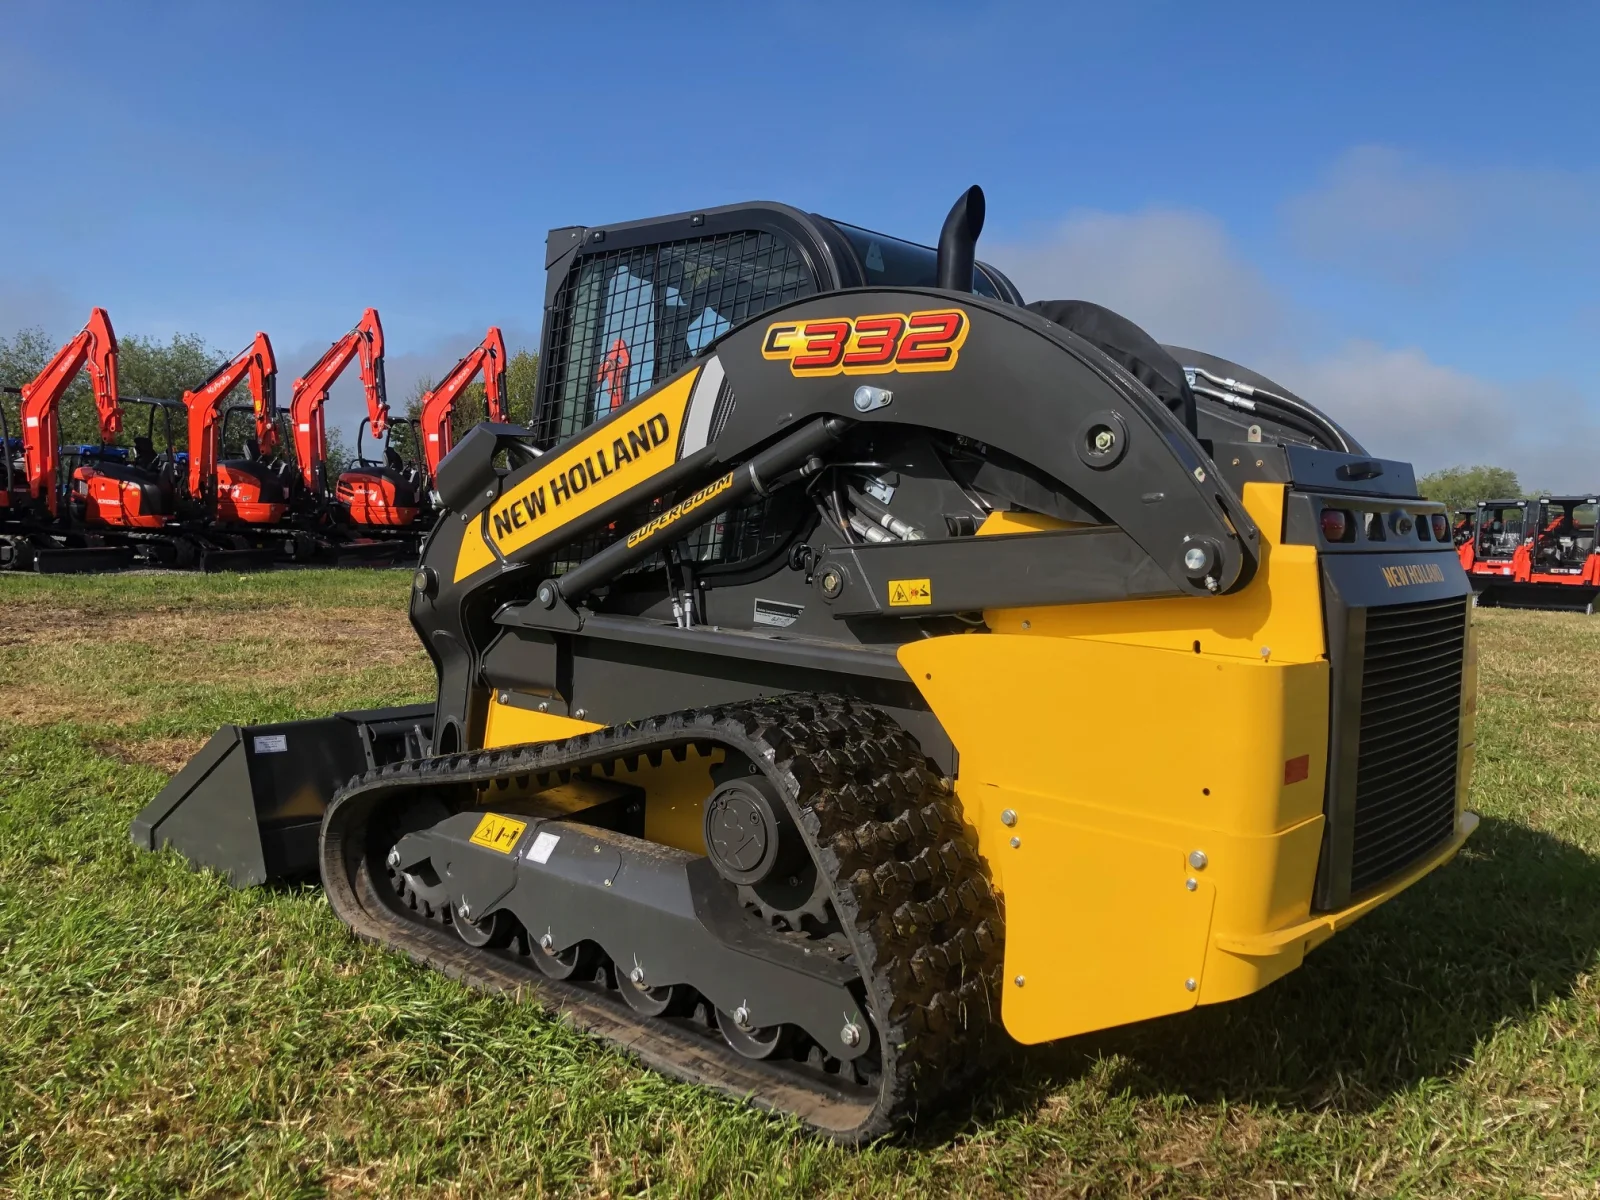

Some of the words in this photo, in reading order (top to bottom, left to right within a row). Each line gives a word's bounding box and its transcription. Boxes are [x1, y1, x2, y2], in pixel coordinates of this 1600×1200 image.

[763, 310, 969, 376] C332
[206, 375, 231, 394] Kubota
[493, 485, 548, 541] NEW
[549, 412, 671, 507] HOLLAND
[628, 504, 682, 547] SUPER
[682, 472, 734, 514] BOOM
[1381, 565, 1410, 588] NEW
[1405, 563, 1445, 585] HOLLAND
